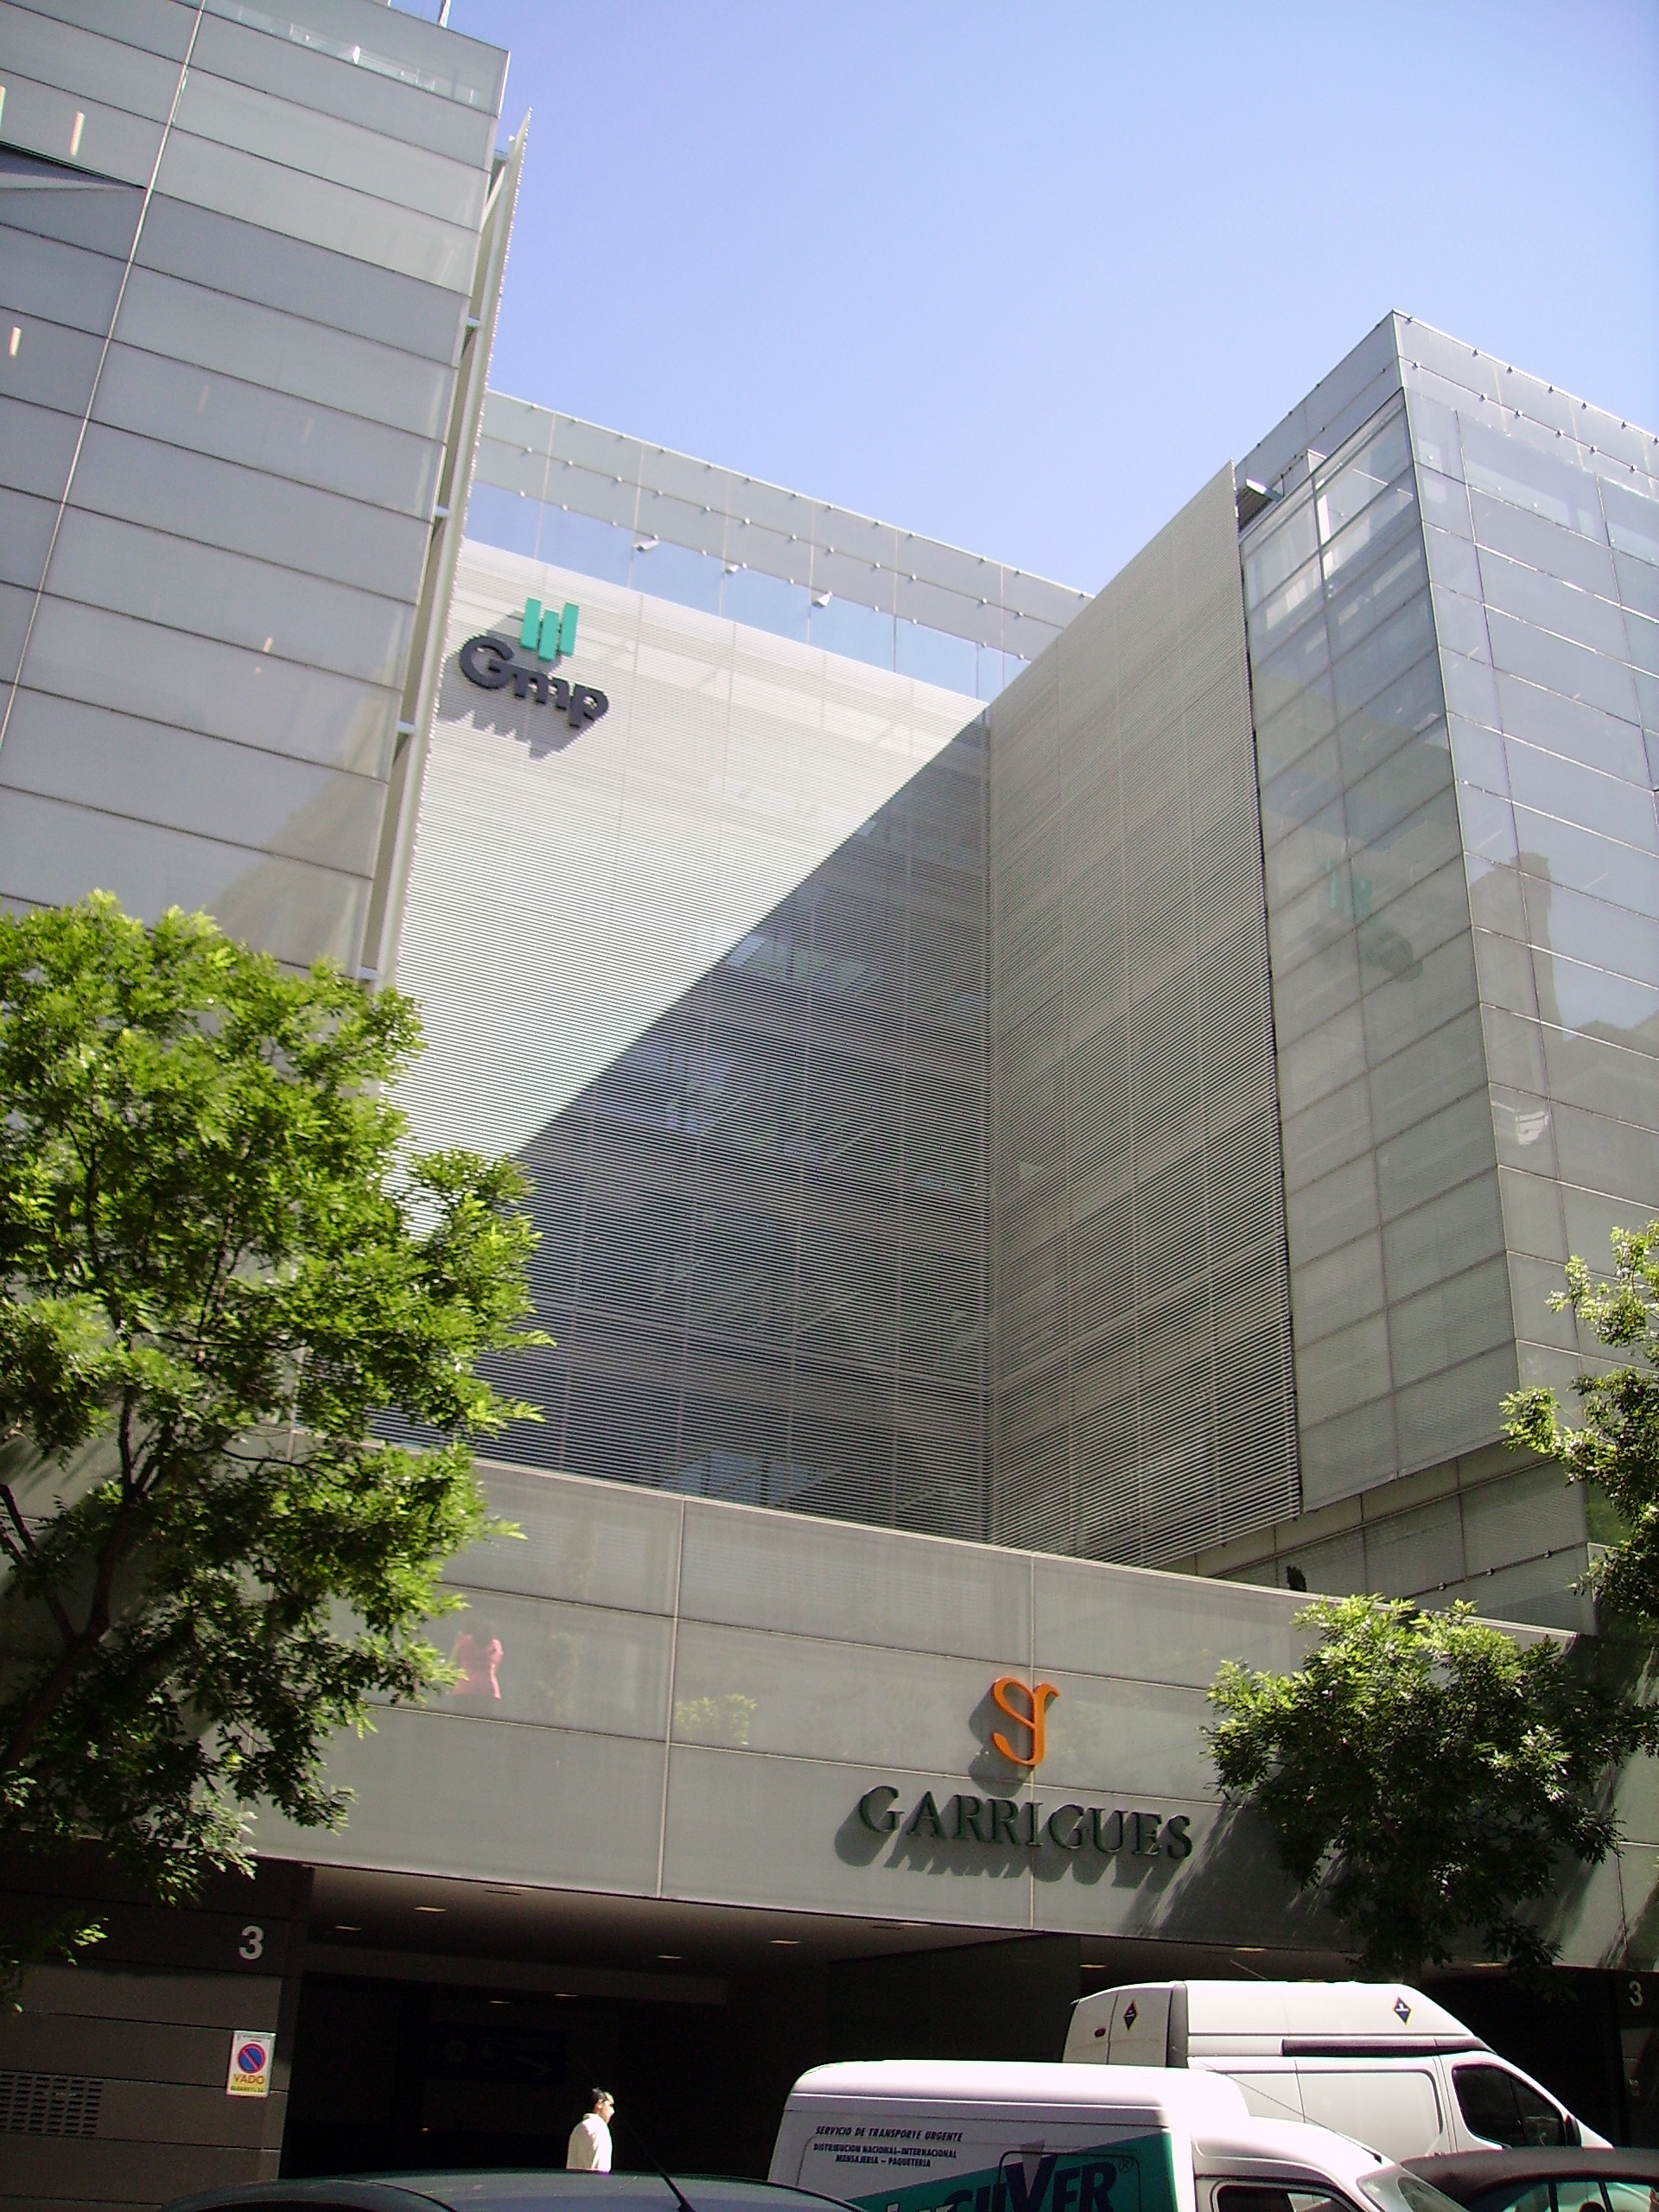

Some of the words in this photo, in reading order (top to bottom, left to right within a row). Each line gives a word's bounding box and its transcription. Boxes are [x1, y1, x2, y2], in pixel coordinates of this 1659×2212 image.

[459, 636, 609, 728] Gmp
[858, 1785, 1193, 1859] GARRIGUES
[238, 1925, 264, 1960] 3
[1629, 1980, 1643, 2006] 3
[232, 2074, 265, 2084] VADO
[815, 2126, 852, 2136] SERVICIO
[855, 2127, 865, 2137] DE
[868, 2128, 922, 2140] TRANSPORTE
[925, 2131, 963, 2142] URGENTE
[888, 2157, 931, 2167] PAQUETERIA
